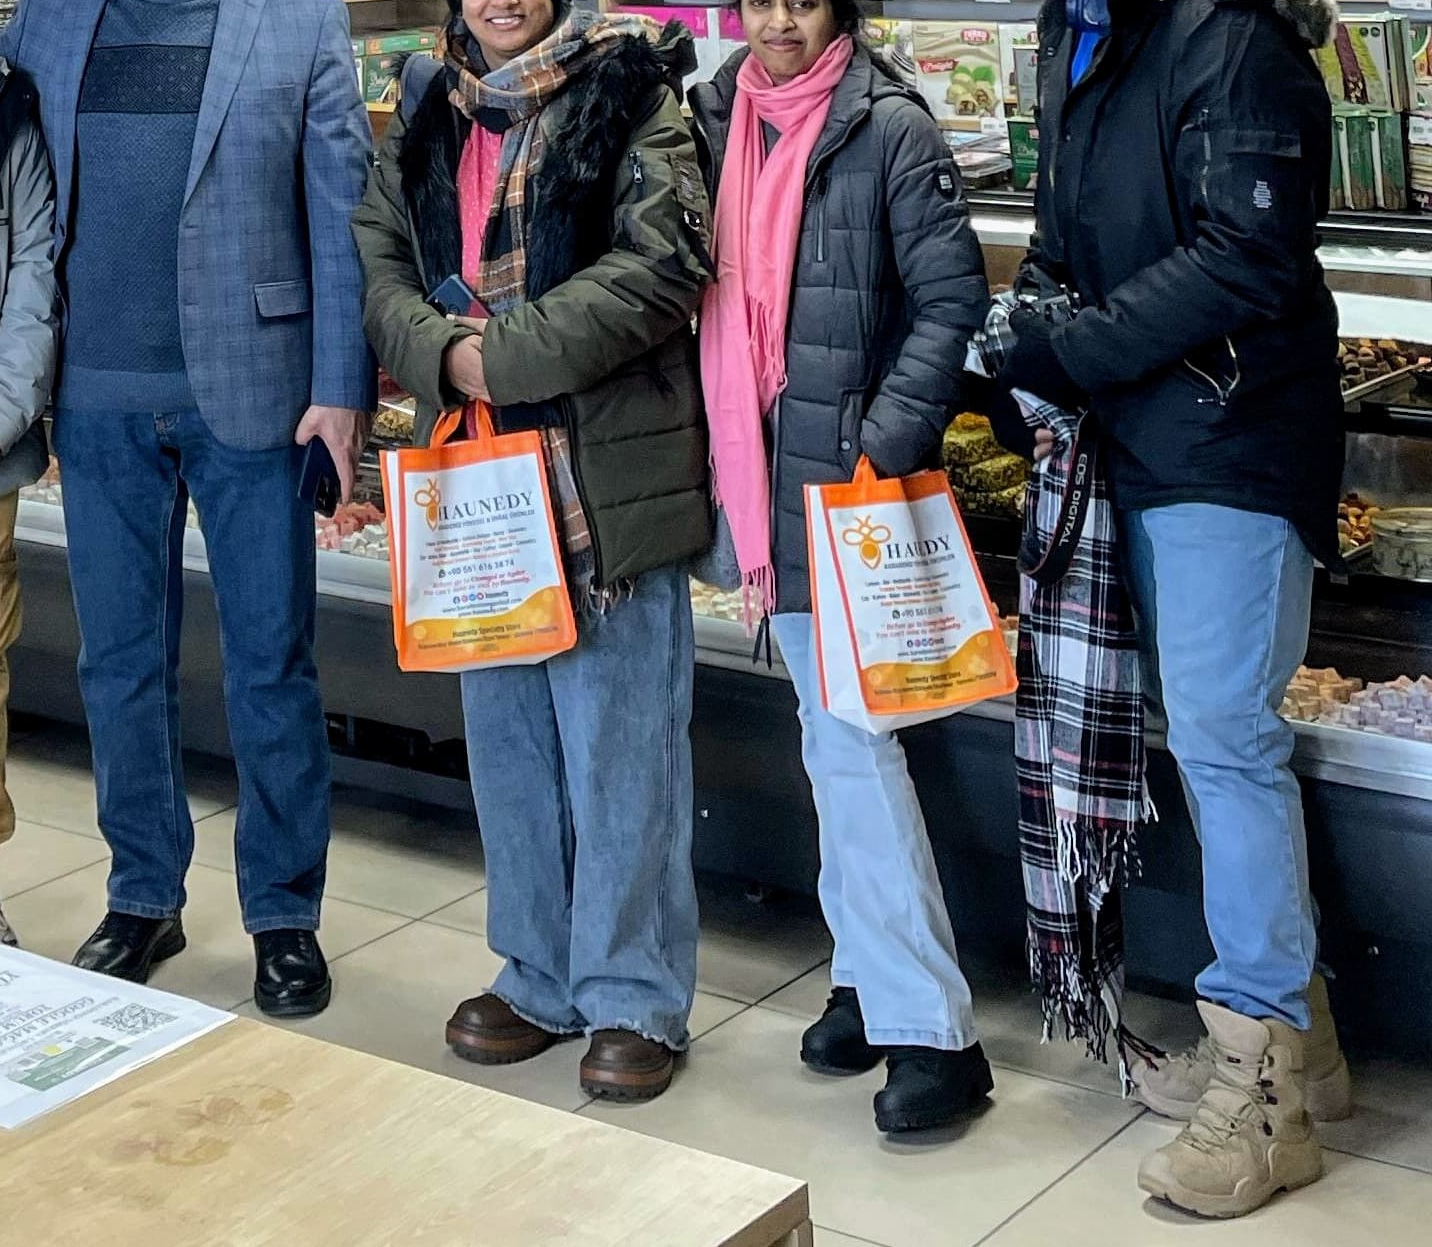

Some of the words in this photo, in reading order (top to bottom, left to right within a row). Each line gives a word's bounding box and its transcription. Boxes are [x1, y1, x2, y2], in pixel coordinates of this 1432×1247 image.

[1075, 453, 1088, 486] EOS
[438, 490, 533, 522] HAUNEDY
[1058, 490, 1082, 547] DIGITAL
[40, 996, 95, 1024] GOOGLE
